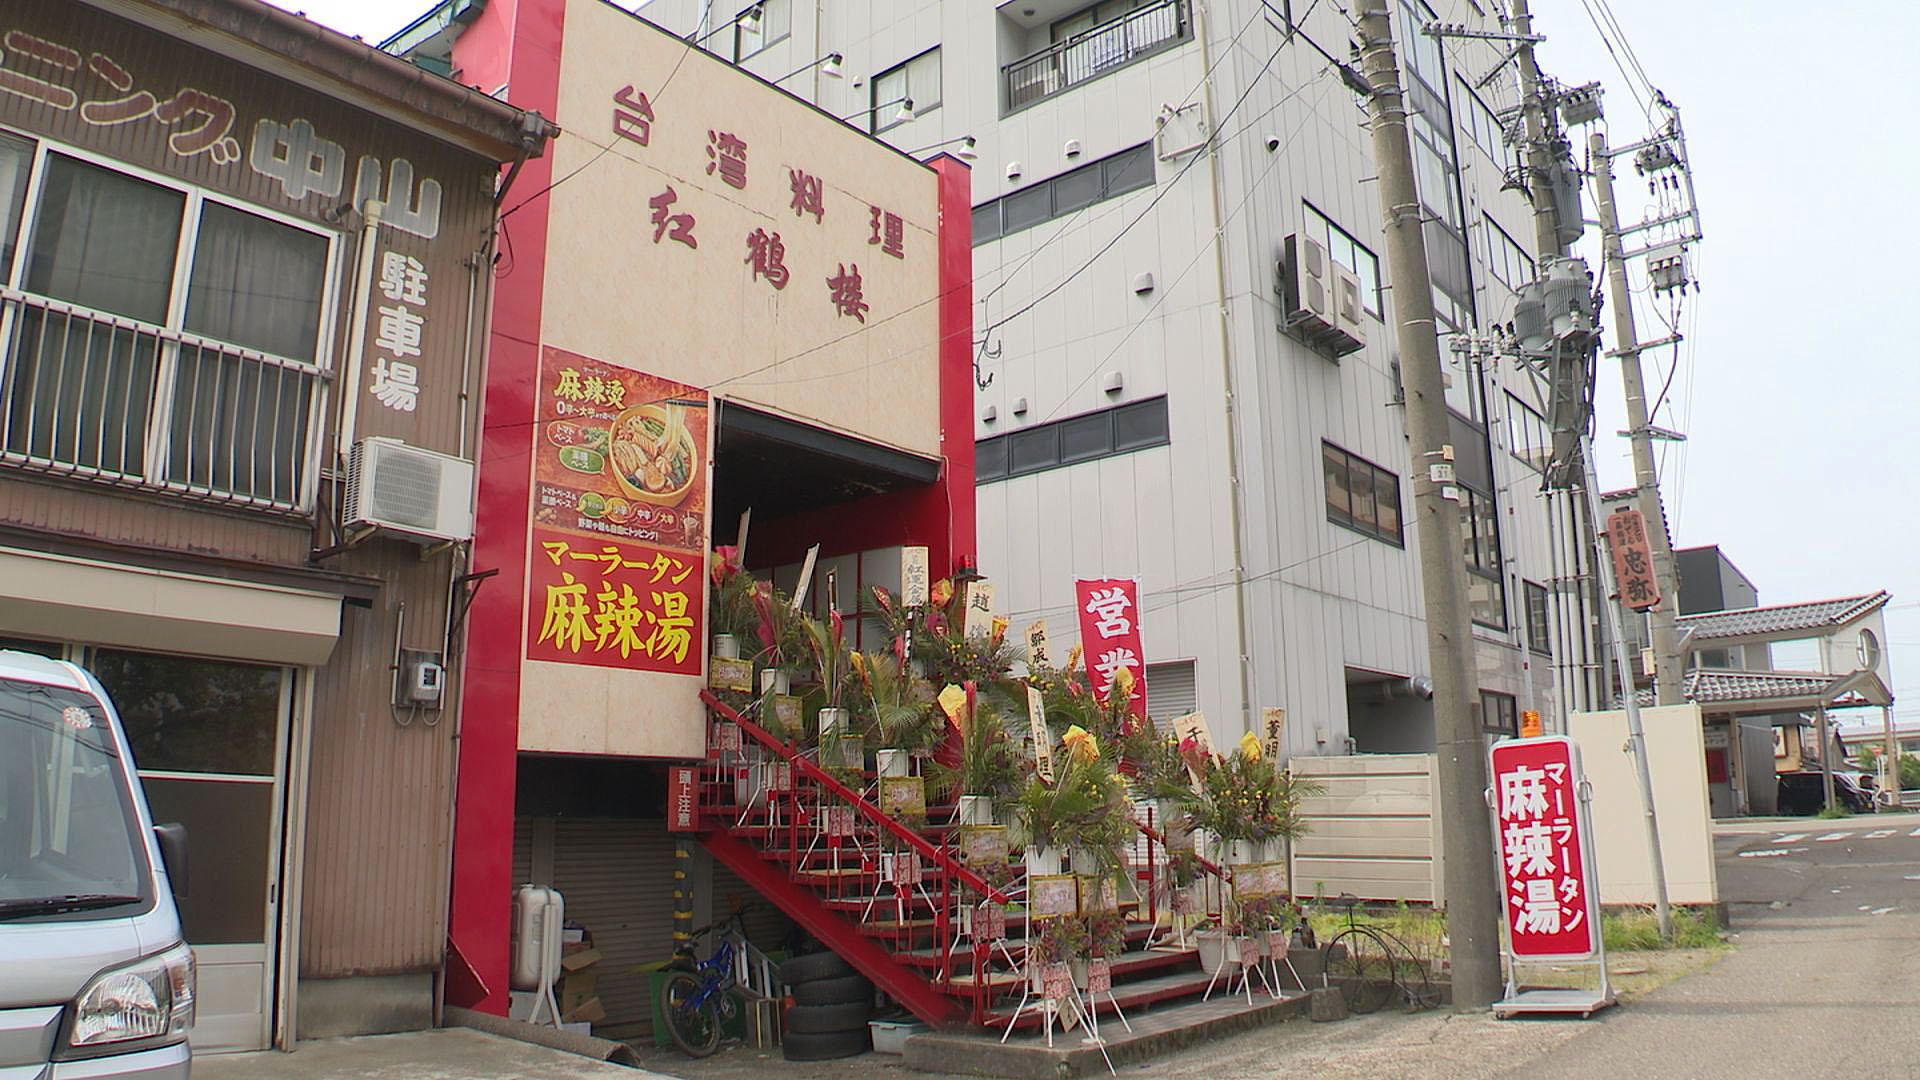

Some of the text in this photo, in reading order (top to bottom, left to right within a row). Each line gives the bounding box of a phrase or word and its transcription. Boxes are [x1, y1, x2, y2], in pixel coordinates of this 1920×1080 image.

[613, 84, 905, 260] 台湾料理
[369, 250, 429, 413] 駐車場
[531, 571, 695, 665] 麻辣湯
[541, 541, 694, 585] マーラータン
[1499, 764, 1561, 936] 麻辣湯
[1543, 762, 1584, 933] マーラータン
